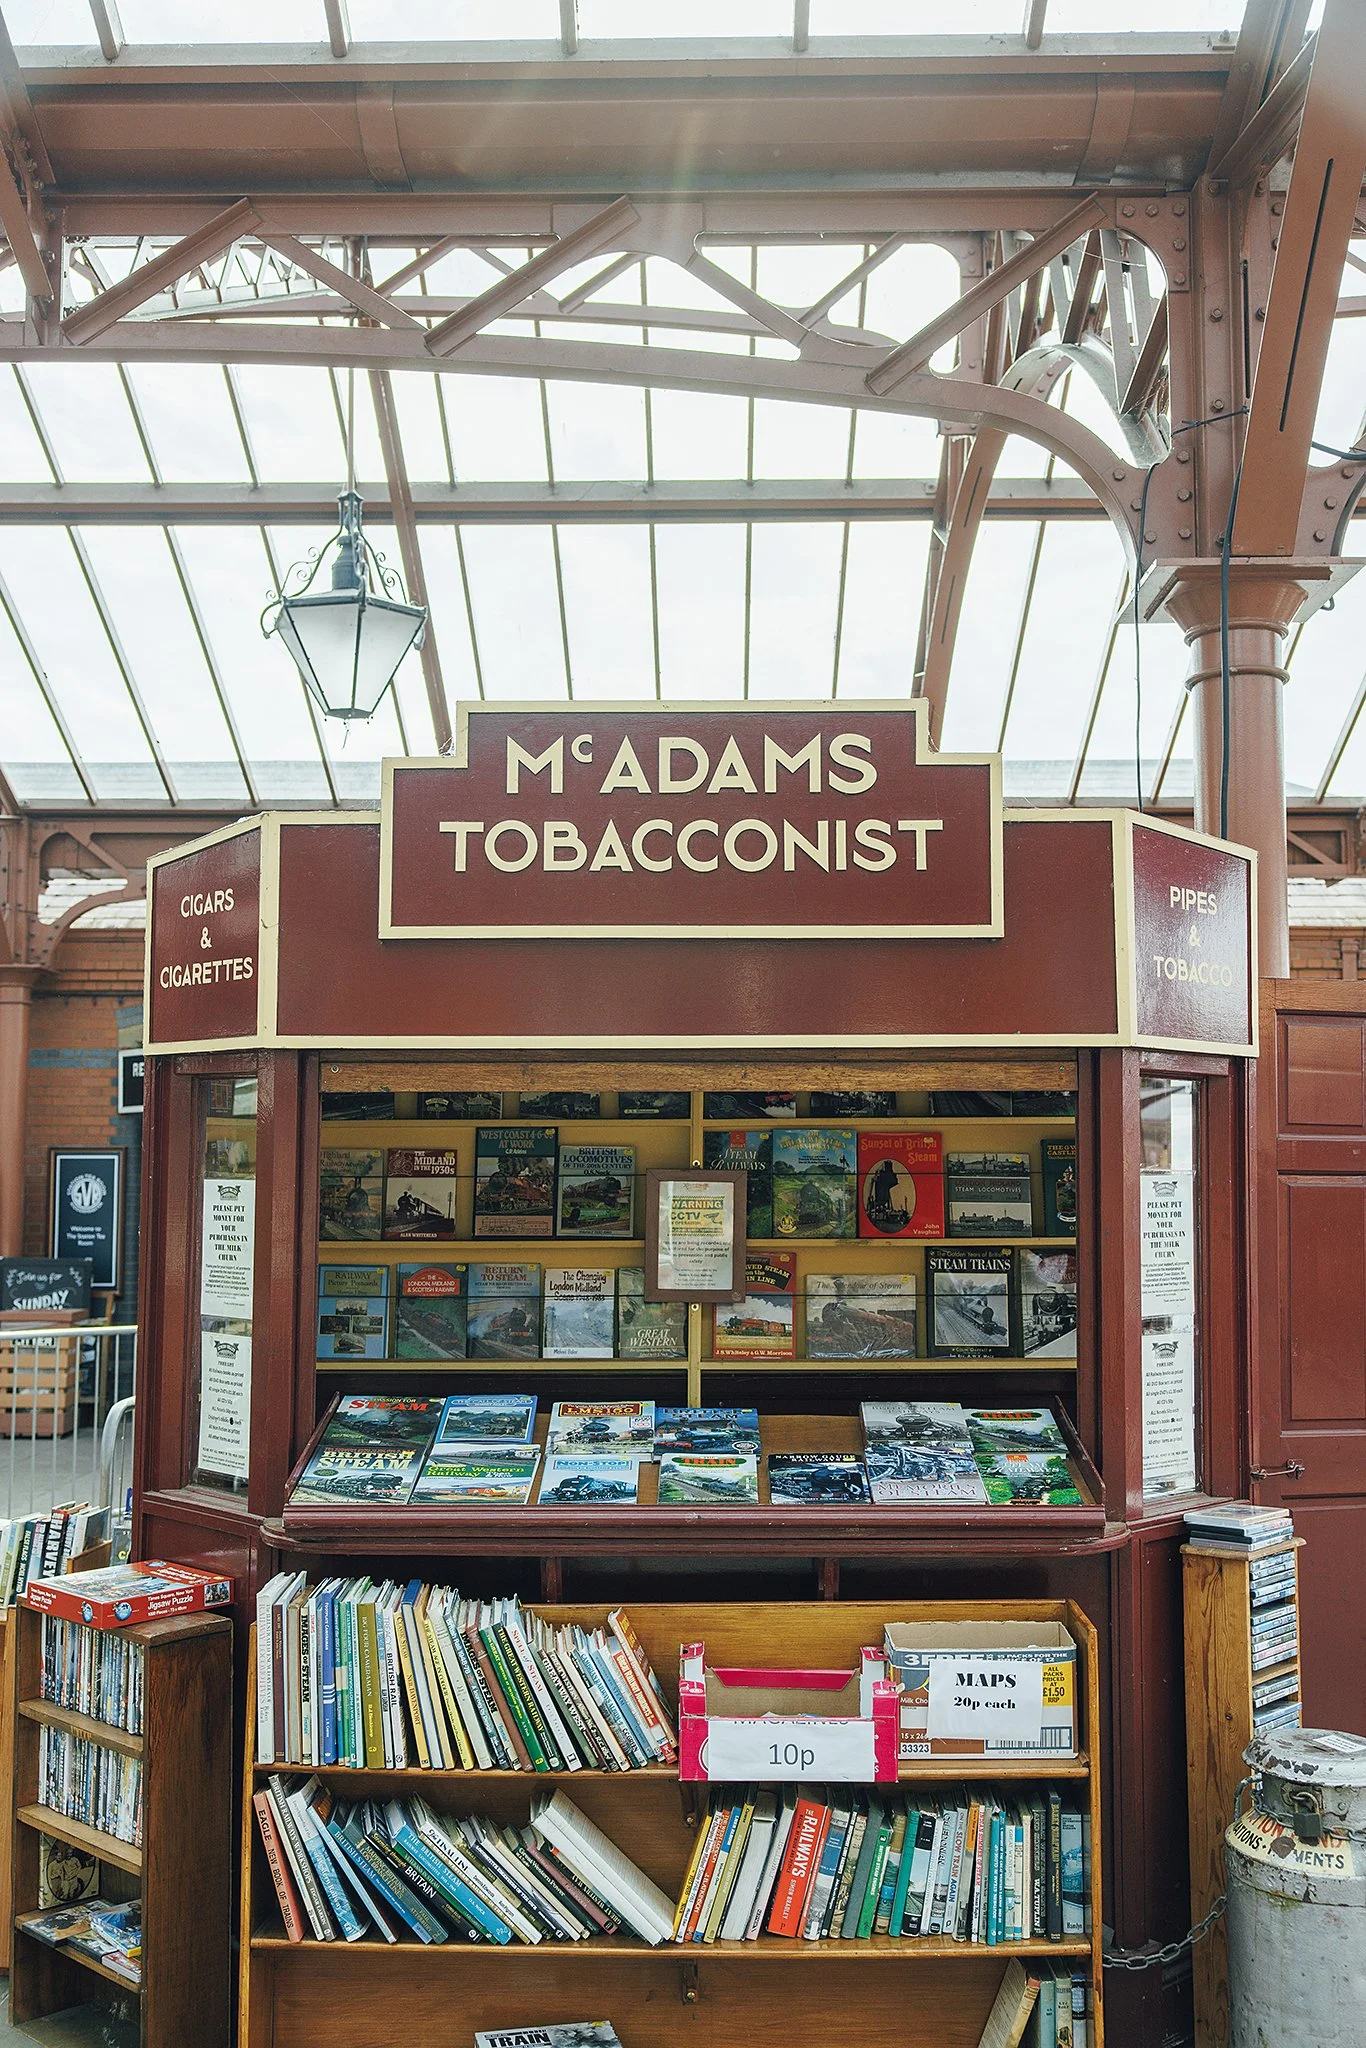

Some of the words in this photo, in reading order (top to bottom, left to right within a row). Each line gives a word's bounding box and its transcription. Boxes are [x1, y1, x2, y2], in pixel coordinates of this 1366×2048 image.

[600, 733, 879, 794] ADAMS
[440, 818, 944, 873] TOBACCONIST
[180, 888, 235, 918] CIGARS
[1170, 886, 1217, 915] PIPES
[200, 926, 212, 949] &
[1189, 925, 1201, 947] &
[160, 956, 254, 989] CIGARETTES
[1153, 955, 1232, 987] TOBACCO
[480, 1130, 501, 1139] WEST
[861, 1139, 893, 1150] Sunset
[414, 1156, 455, 1166] MIDLAND
[563, 1155, 633, 1163] LOCOMOTIVES
[908, 1153, 937, 1165] Steam
[431, 1166, 455, 1175] 1930s
[672, 1199, 722, 1209] WARNING
[930, 1258, 967, 1270] STEAM
[968, 1258, 1011, 1270] TRAINS
[550, 1281, 574, 1291] London
[576, 1270, 606, 1284] Changing
[12, 1289, 69, 1310] SUNDAY
[629, 1337, 678, 1346] WESTERN
[349, 1400, 429, 1411] STEAM
[317, 1459, 413, 1470] STEAM
[42, 1518, 64, 1578] HARVEY
[147, 1599, 172, 1611] Jigsaw
[172, 1595, 194, 1605] Puzzle
[301, 1615, 309, 1655] IMAGES
[387, 1653, 396, 1687] BRITISH
[511, 1629, 524, 1655] SPELL
[528, 1664, 543, 1693] STEAM
[302, 1664, 310, 1703] STEAM
[461, 1632, 481, 1668] IMAGES
[479, 1676, 498, 1713] STEAM
[498, 1627, 508, 1641] THE
[504, 1641, 517, 1665] GREAT
[513, 1665, 531, 1699] WESTERN
[527, 1699, 545, 1732] RAILWAY
[956, 1673, 1017, 1688] MAPS
[390, 1688, 398, 1707] RAIL
[1042, 1686, 1065, 1697] £1.50
[953, 1696, 980, 1710] 20p
[985, 1699, 1016, 1709] each
[568, 1705, 587, 1731] WEST
[768, 1743, 815, 1771] 10p
[902, 1743, 930, 1752] 33323
[805, 1808, 814, 1817] THE
[258, 1809, 272, 1841] EAGLE
[272, 1780, 286, 1807] BRITISH
[283, 1809, 297, 1842] RAILWAYS
[294, 1844, 312, 1885] WORKSHOPS
[791, 1815, 819, 1879] RAILWAYS
[954, 1831, 963, 1853] SLOW
[268, 1848, 278, 1865] NEW
[335, 1831, 357, 1857] BRITISH
[356, 1857, 376, 1879] STEAM
[407, 1832, 421, 1846] THE
[420, 1844, 442, 1868] BRITISH
[442, 1866, 462, 1888] STEAM
[950, 1854, 961, 1878] TRAIN
[273, 1868, 284, 1889] BOOK
[404, 1865, 437, 1898] BRITAIN
[518, 1847, 533, 1862] Great
[531, 1861, 551, 1883] Western
[549, 1881, 566, 1897] Power
[279, 1890, 287, 1900] OF
[788, 1878, 797, 1897] SIMON
[948, 1878, 957, 1903] AGAIN
[282, 1902, 294, 1929] TRAINS
[782, 1897, 793, 1920] BRADLEY
[486, 2032, 551, 2048] TRAIN
